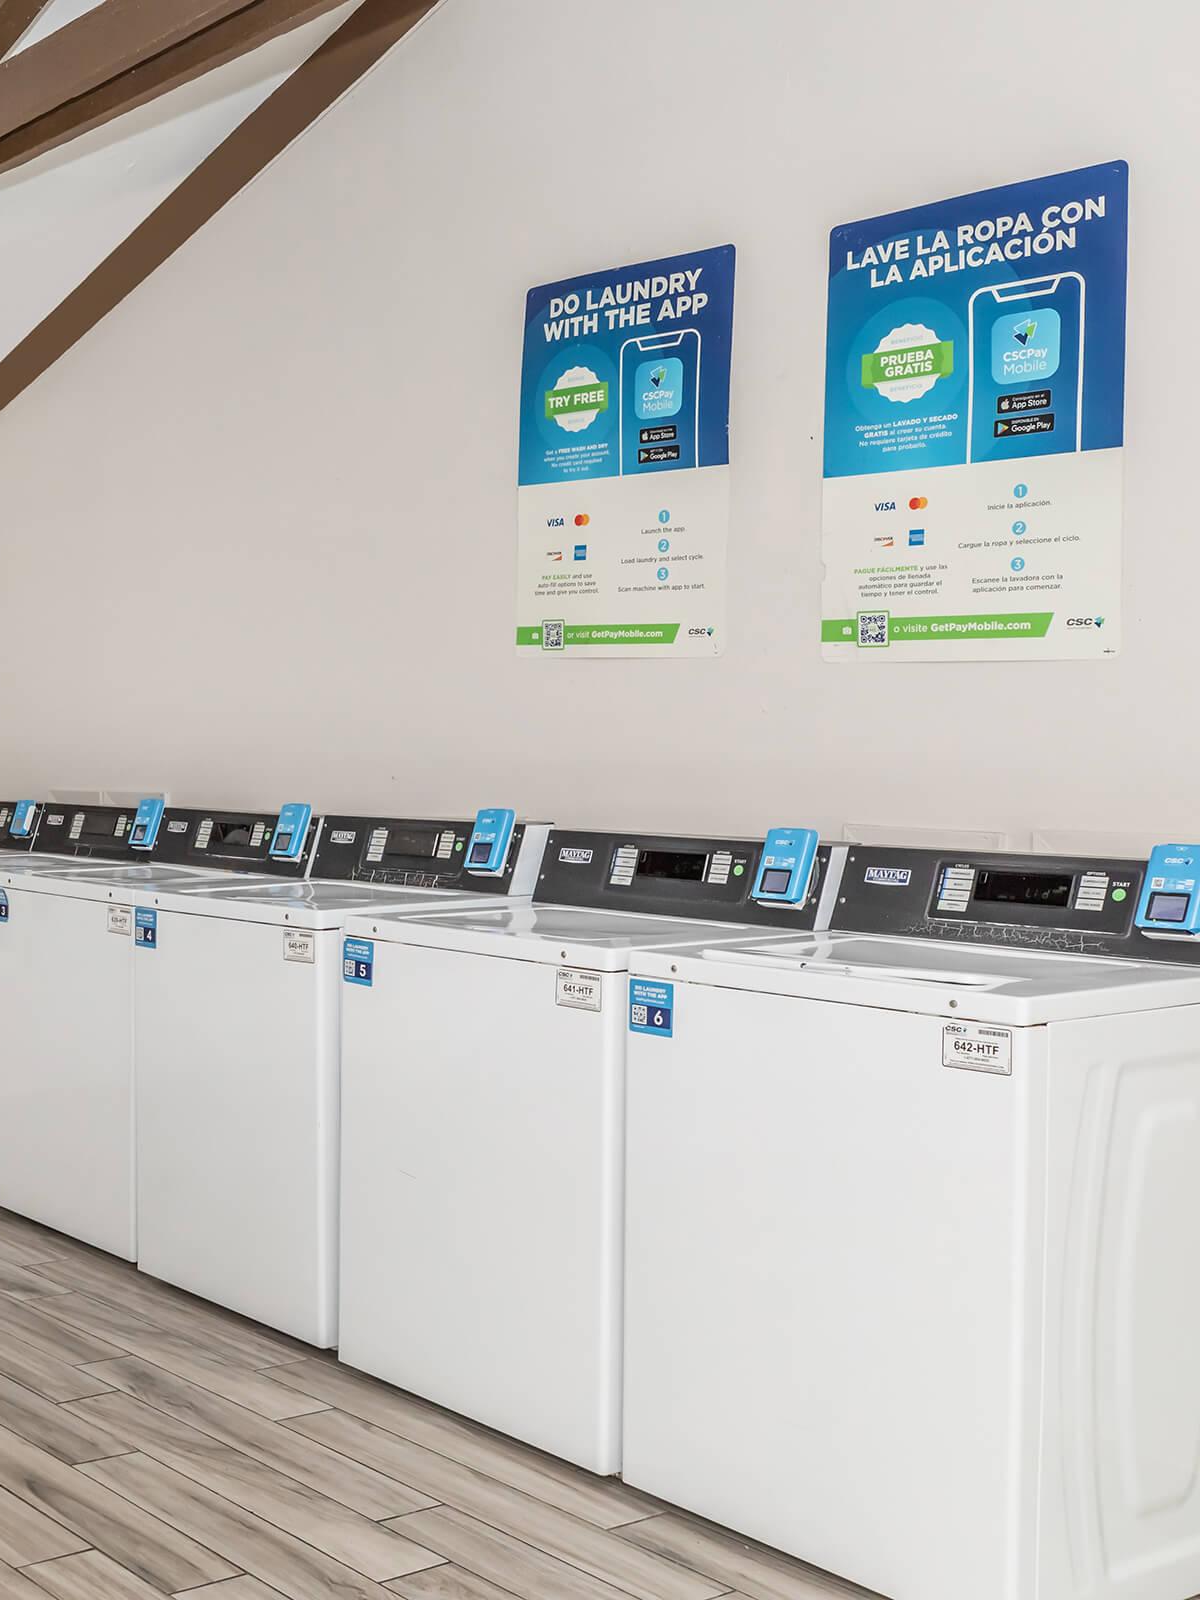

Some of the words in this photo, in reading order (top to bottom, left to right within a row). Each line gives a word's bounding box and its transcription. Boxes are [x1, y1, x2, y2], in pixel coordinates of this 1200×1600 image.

[846, 238, 910, 271] LAVE
[917, 231, 950, 256] LA
[957, 212, 1034, 247] ROPA
[1042, 195, 1106, 228] CON
[870, 264, 903, 288] LA
[909, 226, 1076, 280] APLICACIÓN
[550, 294, 579, 319] DO
[587, 268, 702, 311] LAUNDRY
[543, 313, 598, 342] WITH
[605, 302, 651, 330] THE
[657, 293, 709, 322] APP
[880, 349, 934, 367] PRUEBA
[1003, 348, 1048, 362] CSCPay
[884, 361, 933, 377] GRATIS
[1003, 360, 1047, 376] Mobile
[548, 396, 570, 409] TRY
[574, 390, 604, 404] FREE
[642, 390, 674, 400] CSCPay
[643, 400, 673, 413] Mobile
[1012, 401, 1027, 410] App
[1028, 398, 1047, 407] Store
[893, 418, 921, 427] LAVADO
[929, 413, 958, 422] SECADO
[1011, 423, 1036, 432] Google
[1037, 422, 1051, 430] Play
[864, 430, 888, 438] GRATIS
[650, 452, 666, 460] Google
[874, 502, 896, 511] VISA
[547, 518, 564, 527] VISA
[1015, 537, 1051, 545] seleccione
[972, 585, 1006, 593] aplicación
[902, 623, 928, 633] visite
[931, 621, 1031, 632] GetPayMobile.com
[1066, 618, 1093, 626] CSC
[576, 631, 590, 639] visit
[591, 629, 663, 639] GetPayMobile.com
[688, 628, 706, 636] CSC
[562, 850, 590, 859] MAYTAG
[868, 869, 907, 880] MAYTAG
[360, 964, 366, 977] 5
[564, 984, 593, 995] 641-HTF
[654, 1010, 663, 1026] 6
[954, 1041, 999, 1055] 642-HTF
